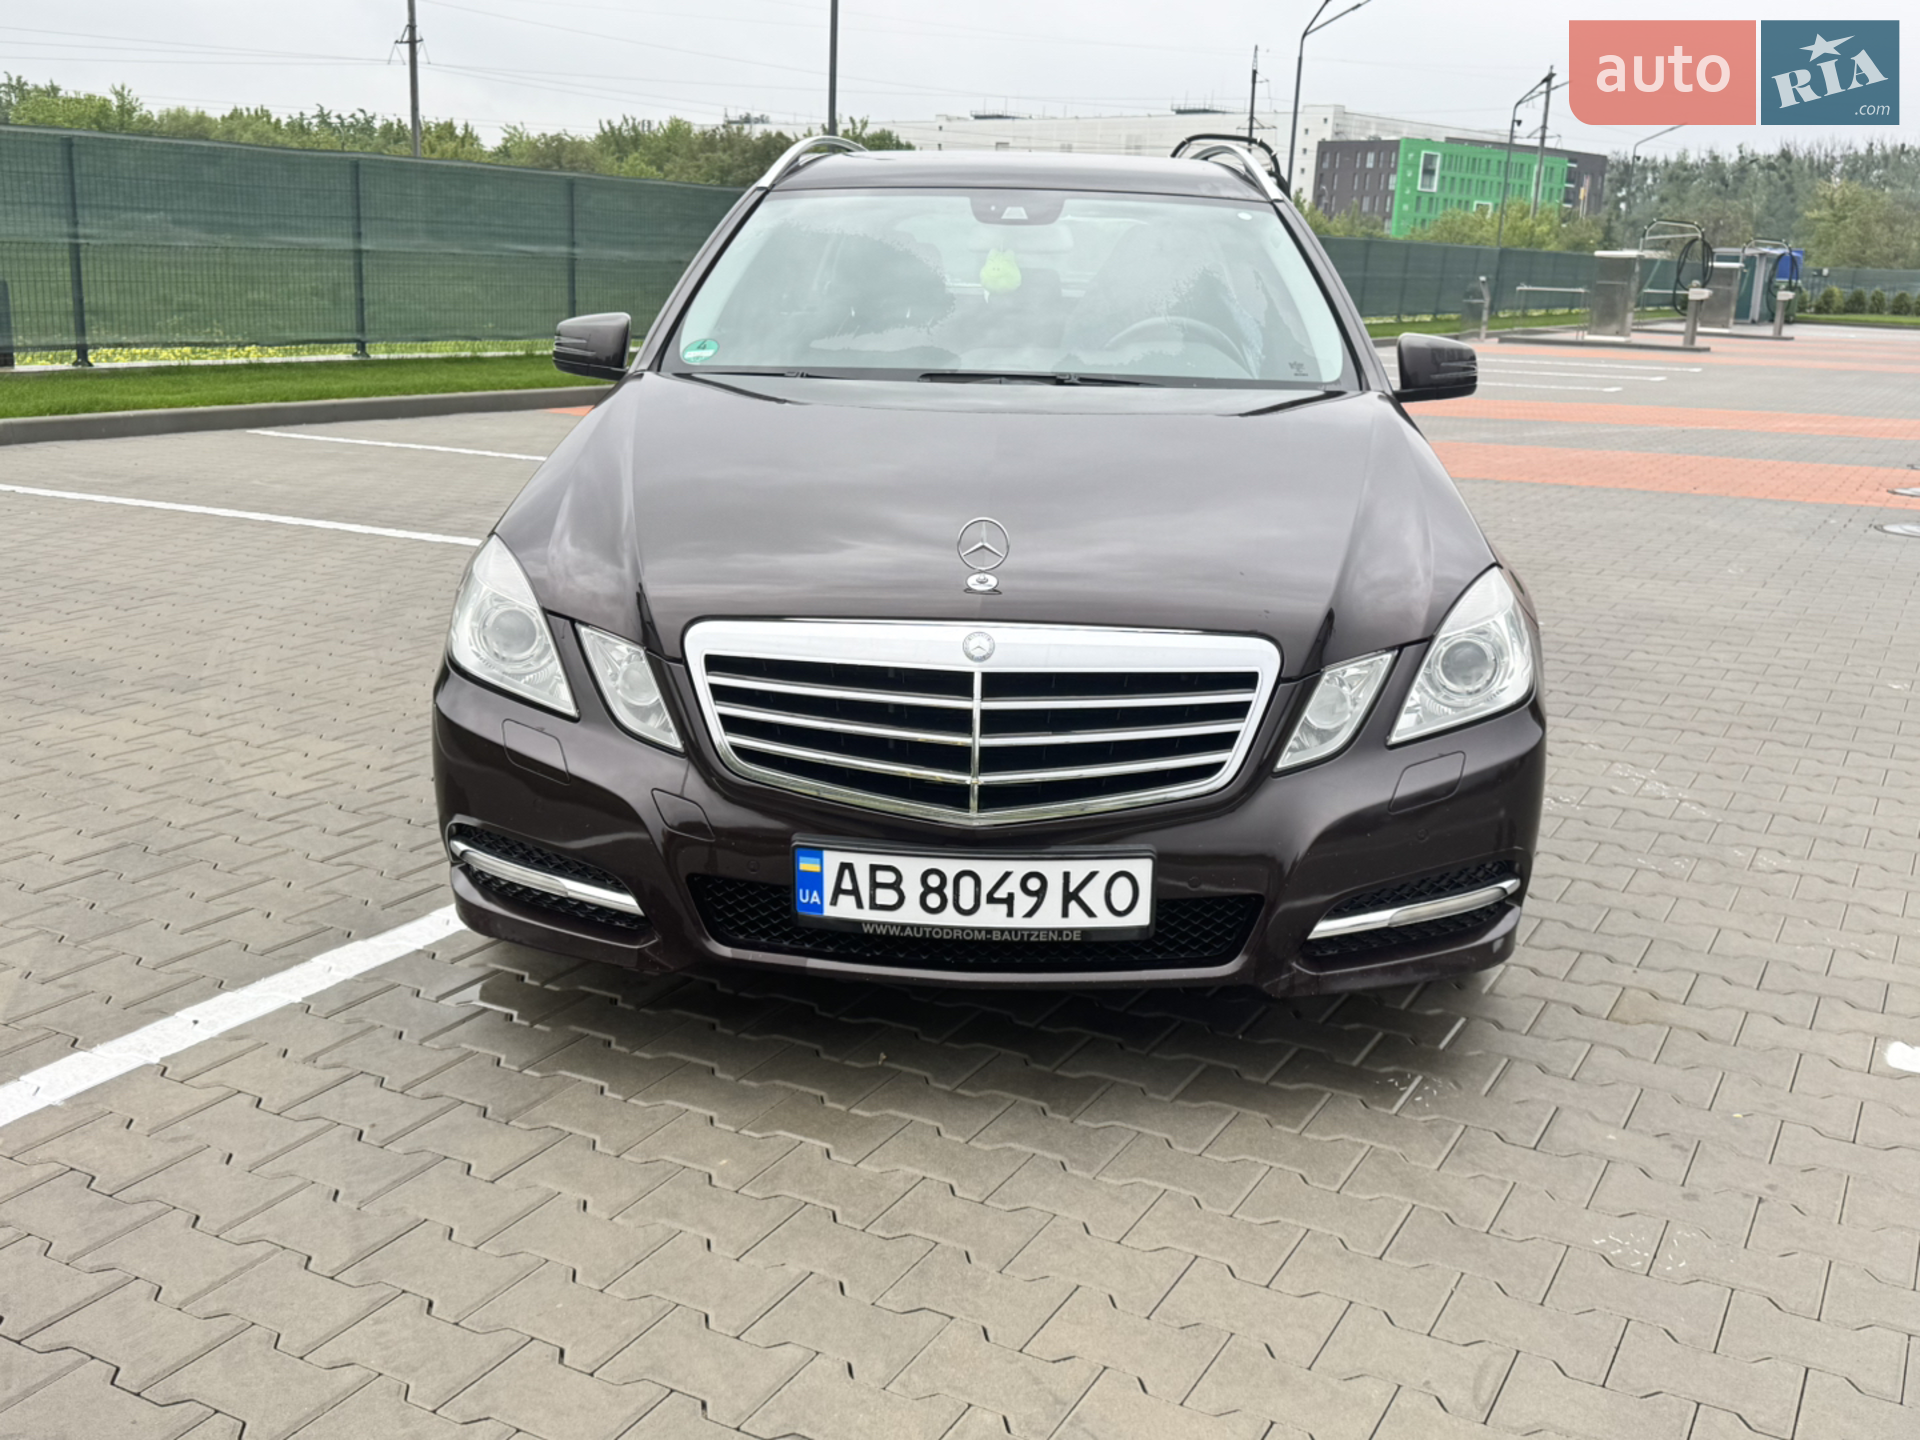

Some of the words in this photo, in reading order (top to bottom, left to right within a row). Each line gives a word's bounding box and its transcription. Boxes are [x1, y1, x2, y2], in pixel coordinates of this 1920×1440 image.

[799, 889, 821, 905] UA
[829, 862, 906, 912] AB
[919, 868, 1049, 919] 8049
[1060, 870, 1140, 919] KO
[862, 922, 1082, 942] WWW.AUTODROM-BAUTZEN.DE
